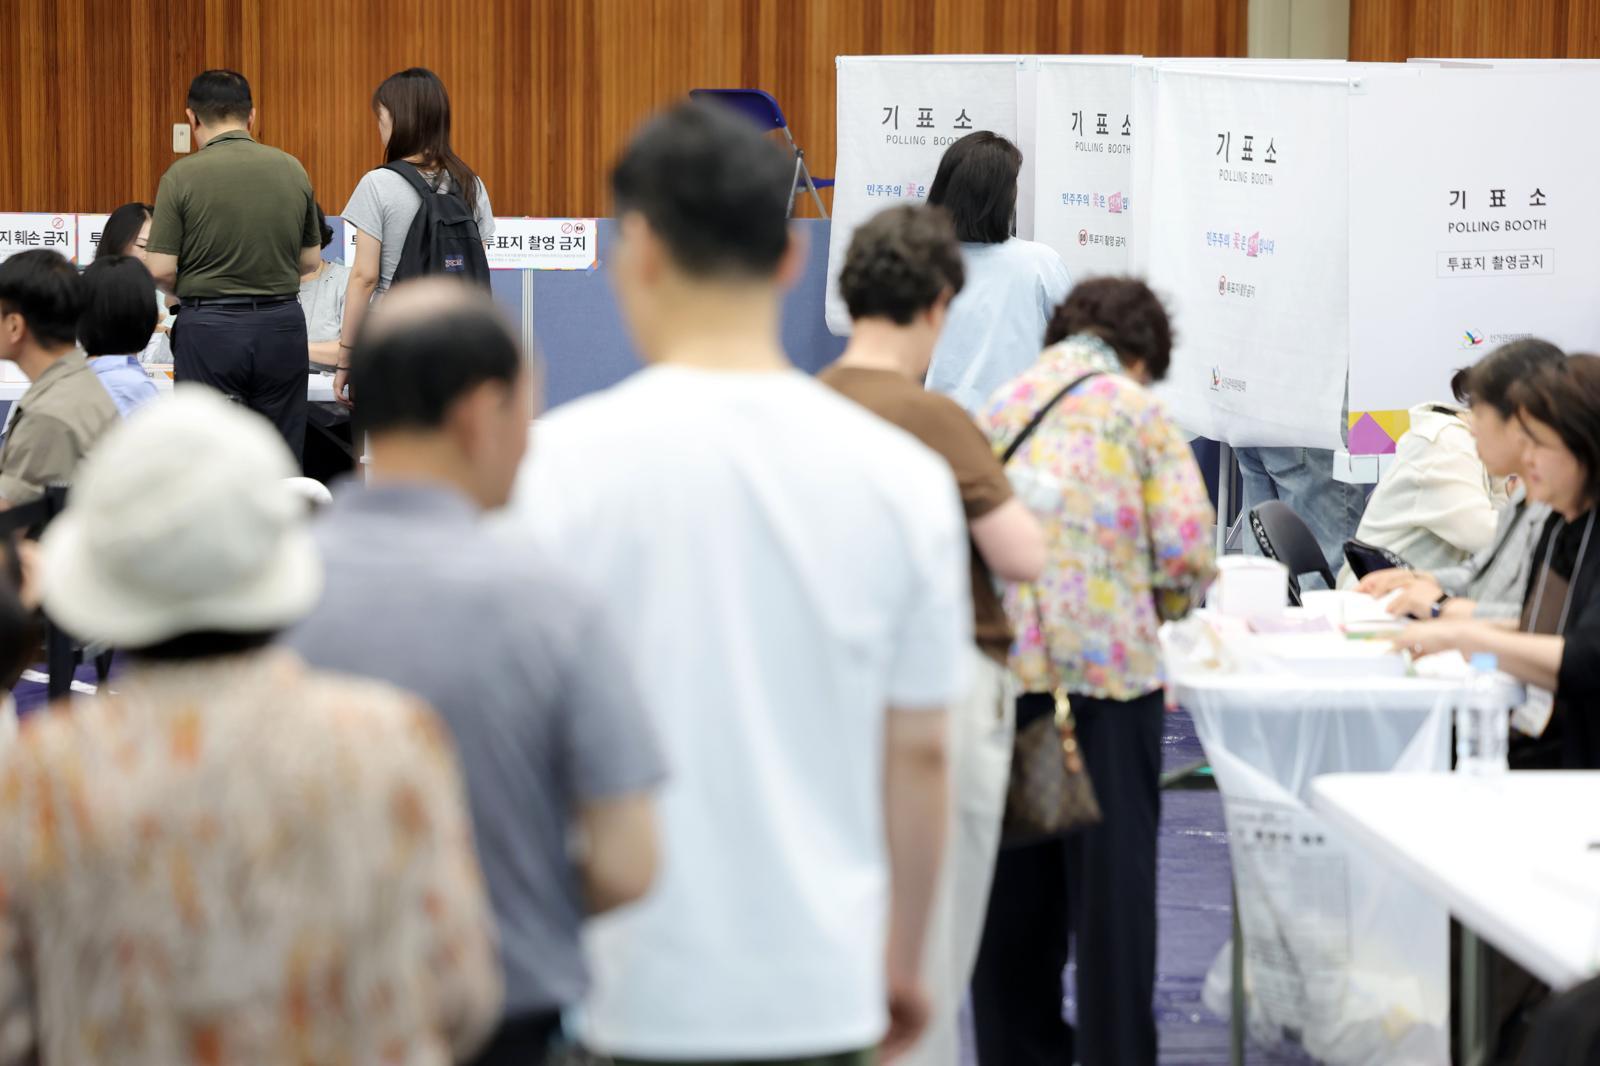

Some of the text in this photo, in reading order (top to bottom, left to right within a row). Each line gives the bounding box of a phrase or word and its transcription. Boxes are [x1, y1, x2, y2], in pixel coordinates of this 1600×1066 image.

[886, 135, 926, 146] POLLING
[1075, 141, 1131, 154] POLLING BOOTH
[1218, 169, 1273, 185] POLLING BOOTH
[866, 184, 902, 197] 민주주의
[1062, 192, 1090, 207] 민주주의
[1448, 219, 1547, 233] POLLING BOOTH
[14, 230, 40, 246] 훼손
[43, 230, 69, 246] 금지
[485, 235, 586, 250] 투표지 촬영 금지
[1447, 254, 1544, 272] 투표지 촬영금지
